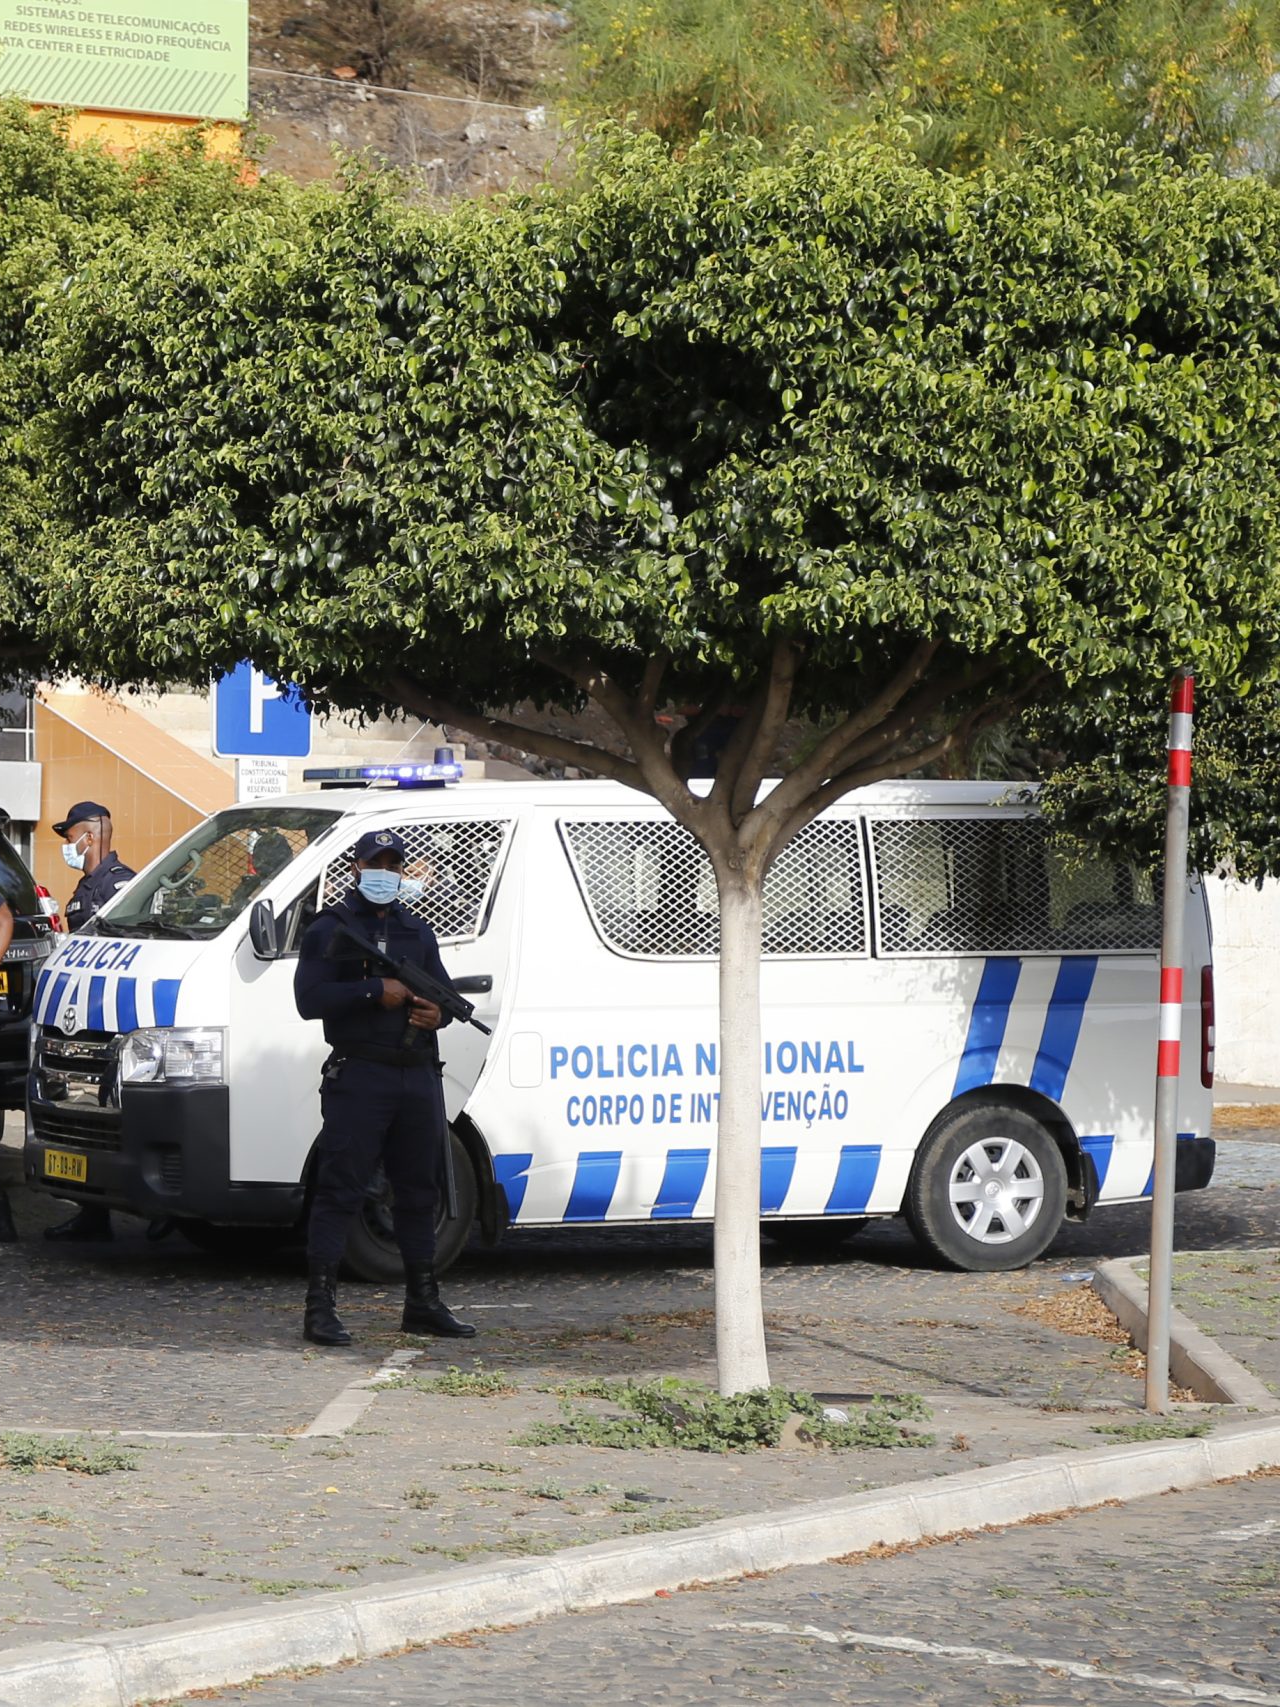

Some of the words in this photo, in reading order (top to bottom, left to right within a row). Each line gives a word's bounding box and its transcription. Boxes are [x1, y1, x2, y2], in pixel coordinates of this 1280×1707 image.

[4, 20, 42, 33] REDES
[45, 24, 102, 40] WIRELESS
[105, 30, 112, 40] E
[115, 30, 153, 44] RÁDIO
[156, 35, 231, 52] FREQUÊNCIA
[16, 5, 75, 20] SISTEMAS
[78, 11, 94, 22] DE
[96, 13, 221, 35] TELECOMUNICAÇÕES
[27, 39, 74, 53] CENTER
[76, 44, 83, 54] E
[86, 44, 170, 62] ELETRICIDADE
[53, 939, 142, 971] POLICIA
[550, 1043, 683, 1079] POLICIA
[695, 1041, 864, 1076] NIONAL
[567, 1093, 644, 1126] CORPO
[652, 1093, 682, 1123] DE
[690, 1083, 848, 1129] INTVENÇÃO
